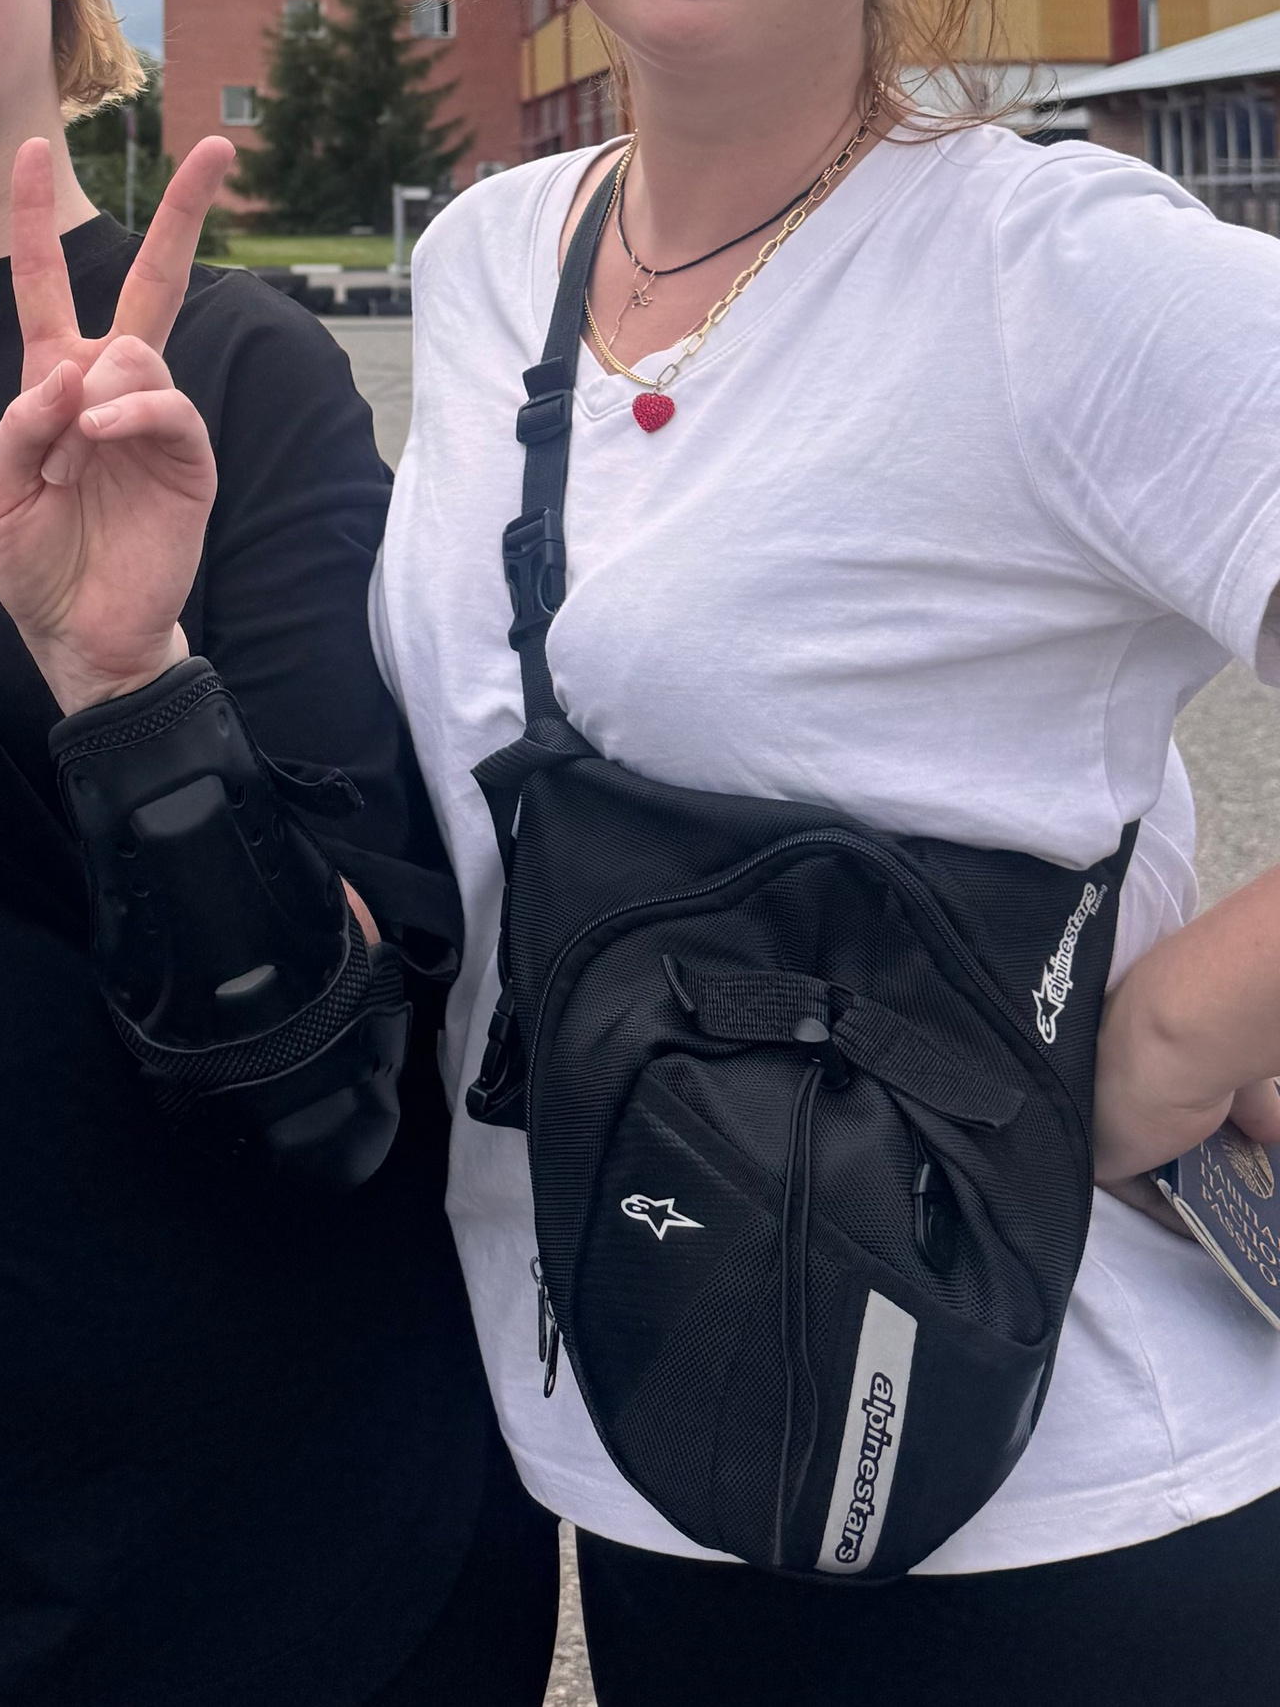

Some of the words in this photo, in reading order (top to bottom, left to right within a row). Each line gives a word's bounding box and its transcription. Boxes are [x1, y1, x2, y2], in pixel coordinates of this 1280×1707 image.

[1046, 882, 1098, 1004] alpinestars
[1200, 1140, 1280, 1251] ПАШПА
[1200, 1161, 1280, 1271] ПАСПО
[1201, 1183, 1280, 1288] PASSPO
[834, 1371, 896, 1564] alpinestars
